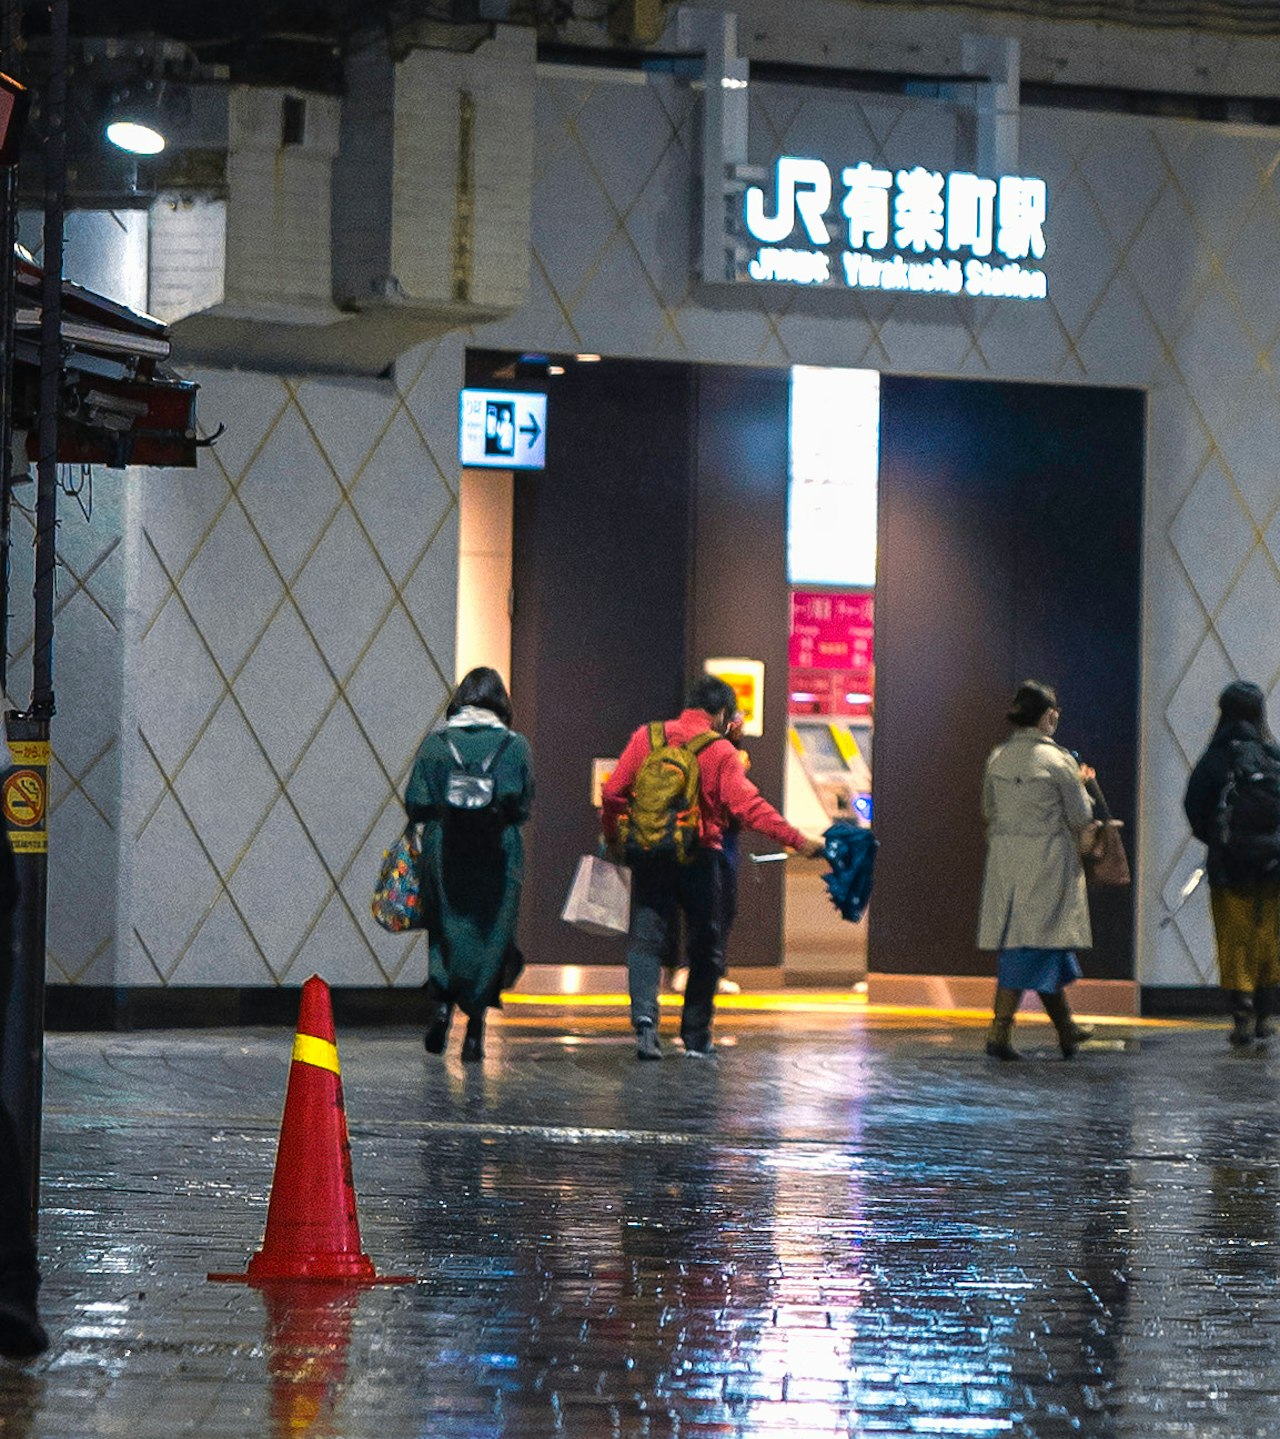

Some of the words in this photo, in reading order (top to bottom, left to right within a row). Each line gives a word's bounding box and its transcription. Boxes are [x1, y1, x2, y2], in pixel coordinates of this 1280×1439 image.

[746, 156, 832, 245] JR
[841, 162, 1047, 260] 有楽町駅
